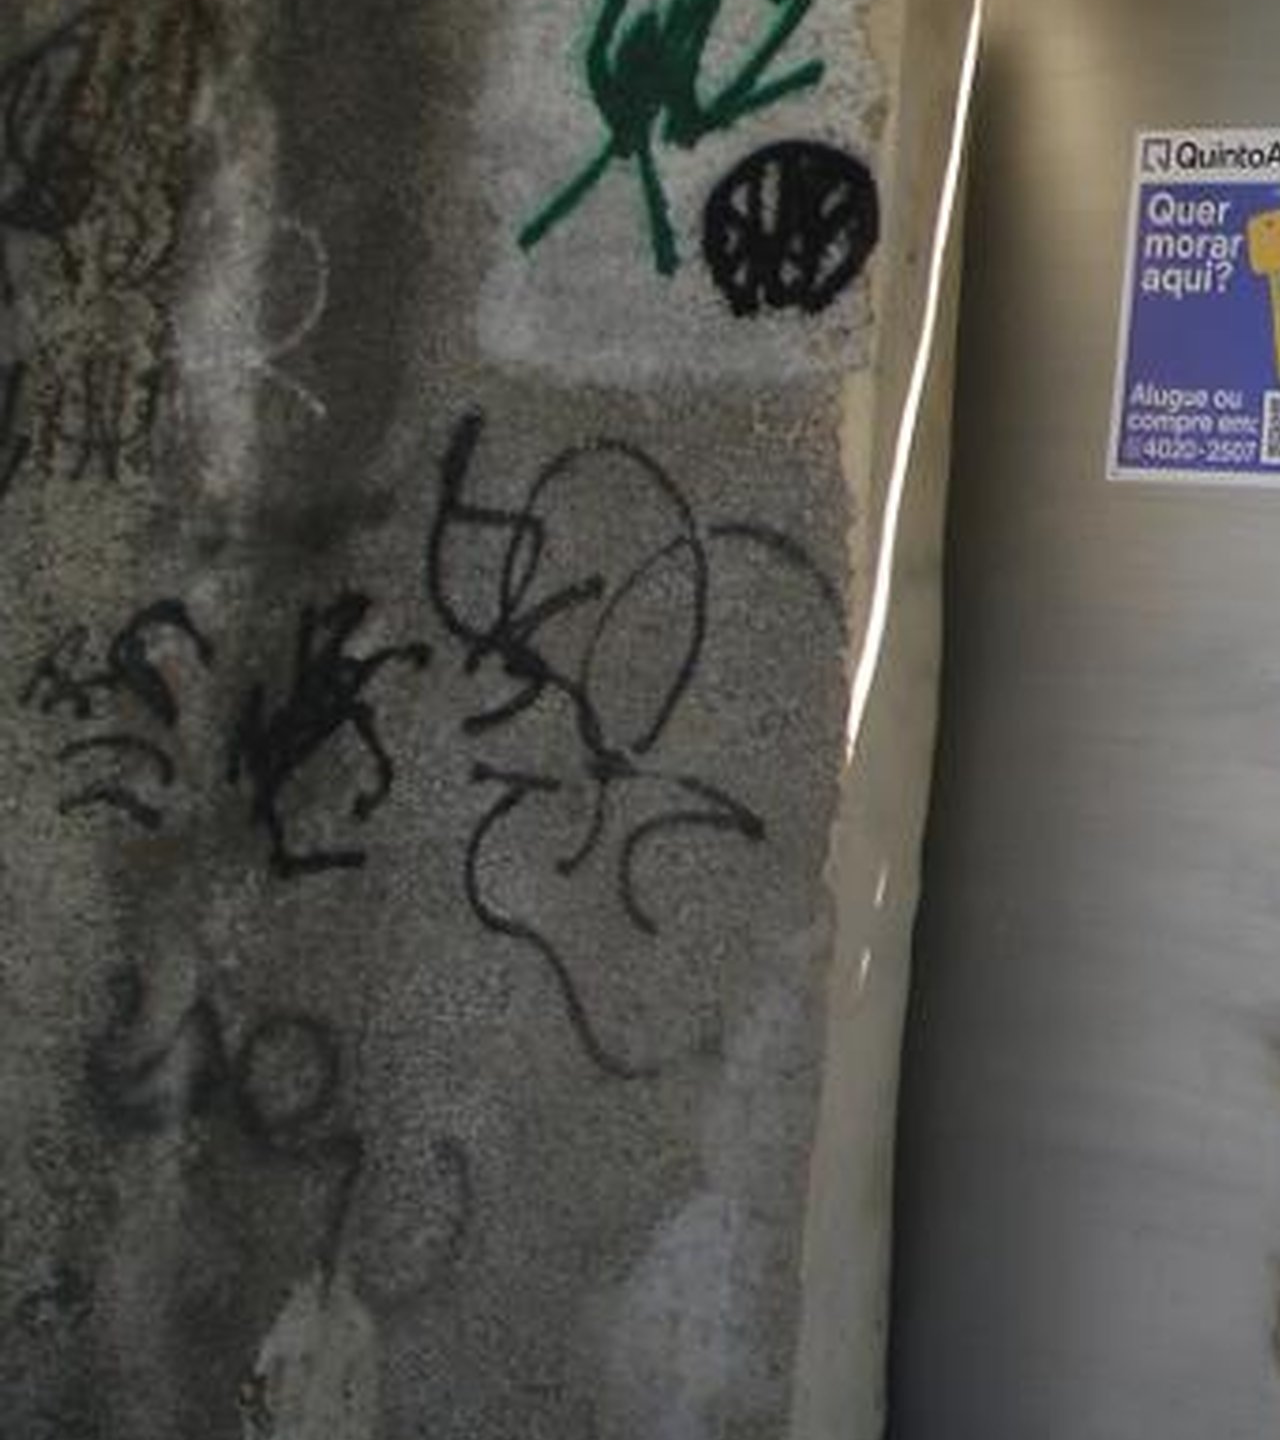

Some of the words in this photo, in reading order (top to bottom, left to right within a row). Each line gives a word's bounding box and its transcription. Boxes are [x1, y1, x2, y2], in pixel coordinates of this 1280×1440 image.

[1147, 192, 1231, 224] Quer
[1144, 233, 1244, 258] morar
[1141, 262, 1233, 298] aqui?
[1130, 383, 1208, 411] Alugue
[1213, 389, 1243, 409] ou
[1128, 414, 1213, 437] compre
